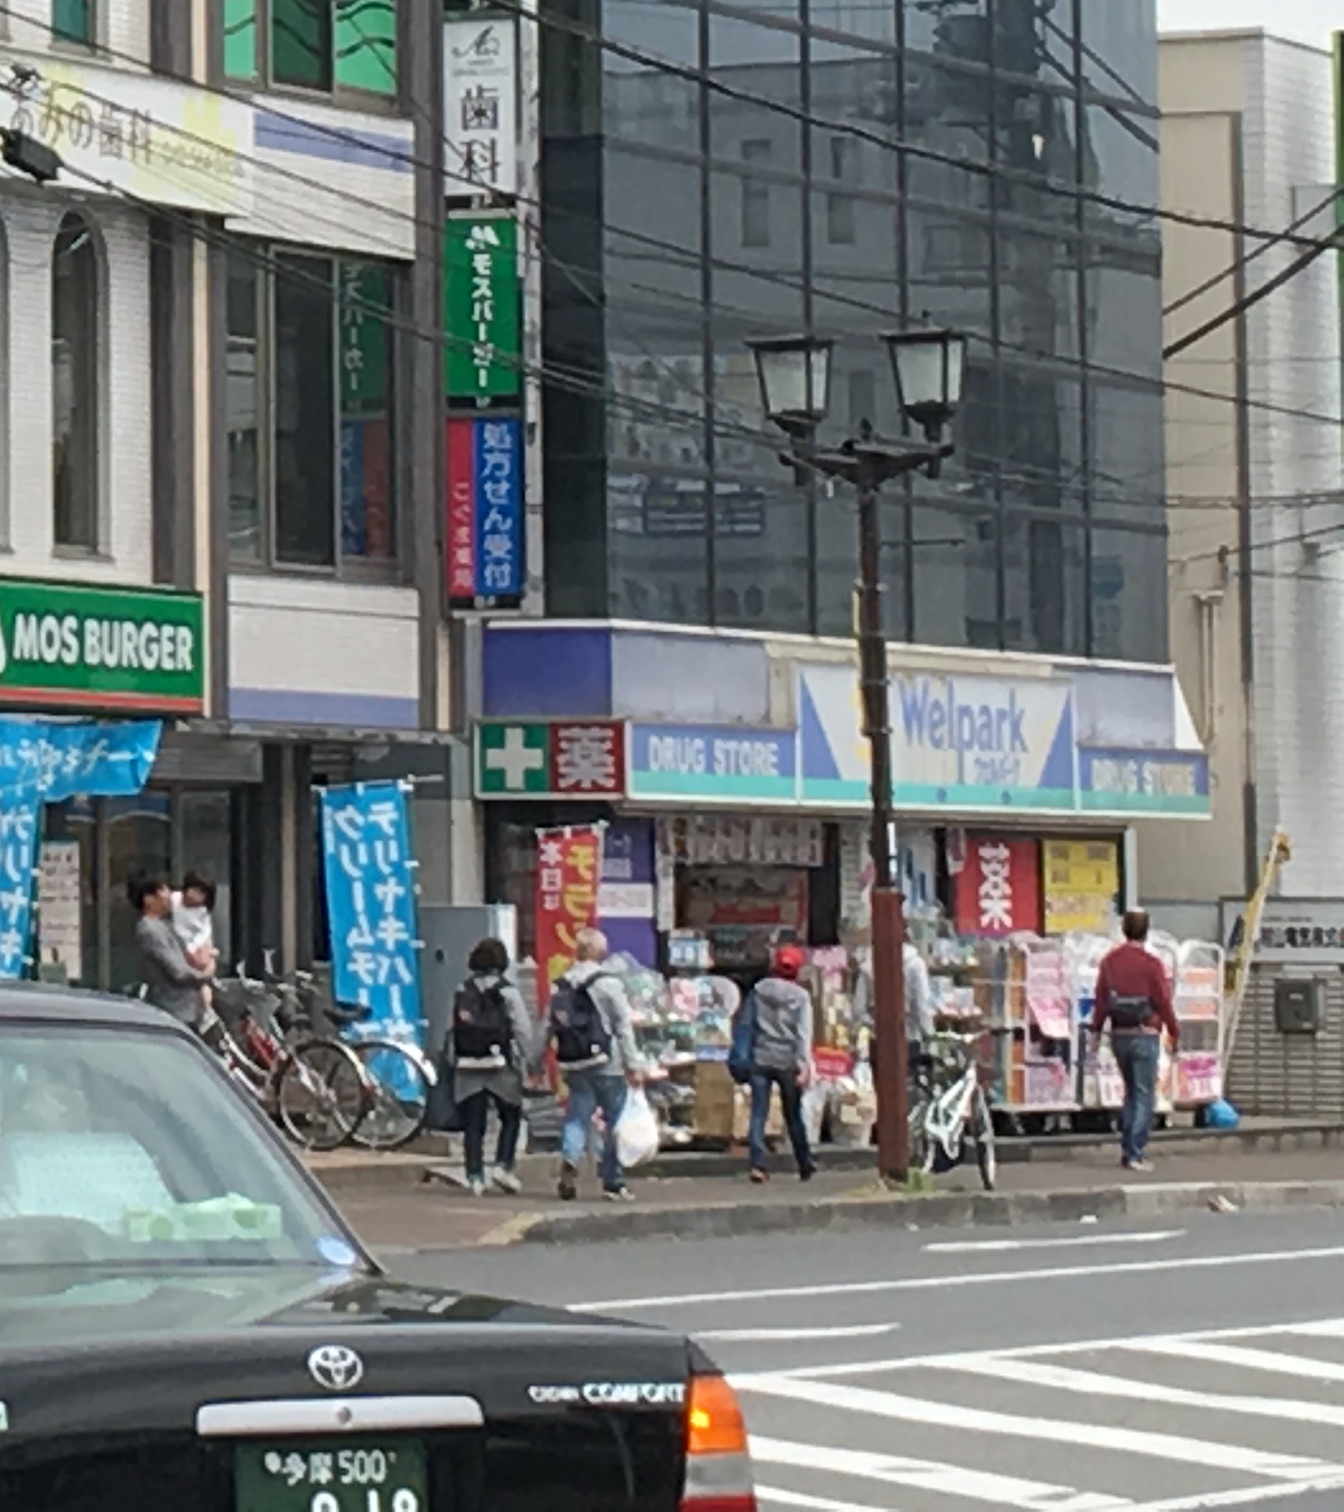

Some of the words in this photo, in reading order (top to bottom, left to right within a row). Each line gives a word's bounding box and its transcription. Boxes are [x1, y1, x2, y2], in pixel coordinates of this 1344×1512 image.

[14, 613, 79, 665] MOS
[83, 618, 195, 671] BURGER
[557, 726, 617, 789] 薬
[649, 732, 707, 774] DRUG
[713, 737, 780, 777] STORE
[899, 677, 1028, 785] Welpark
[338, 1449, 388, 1485] 500
